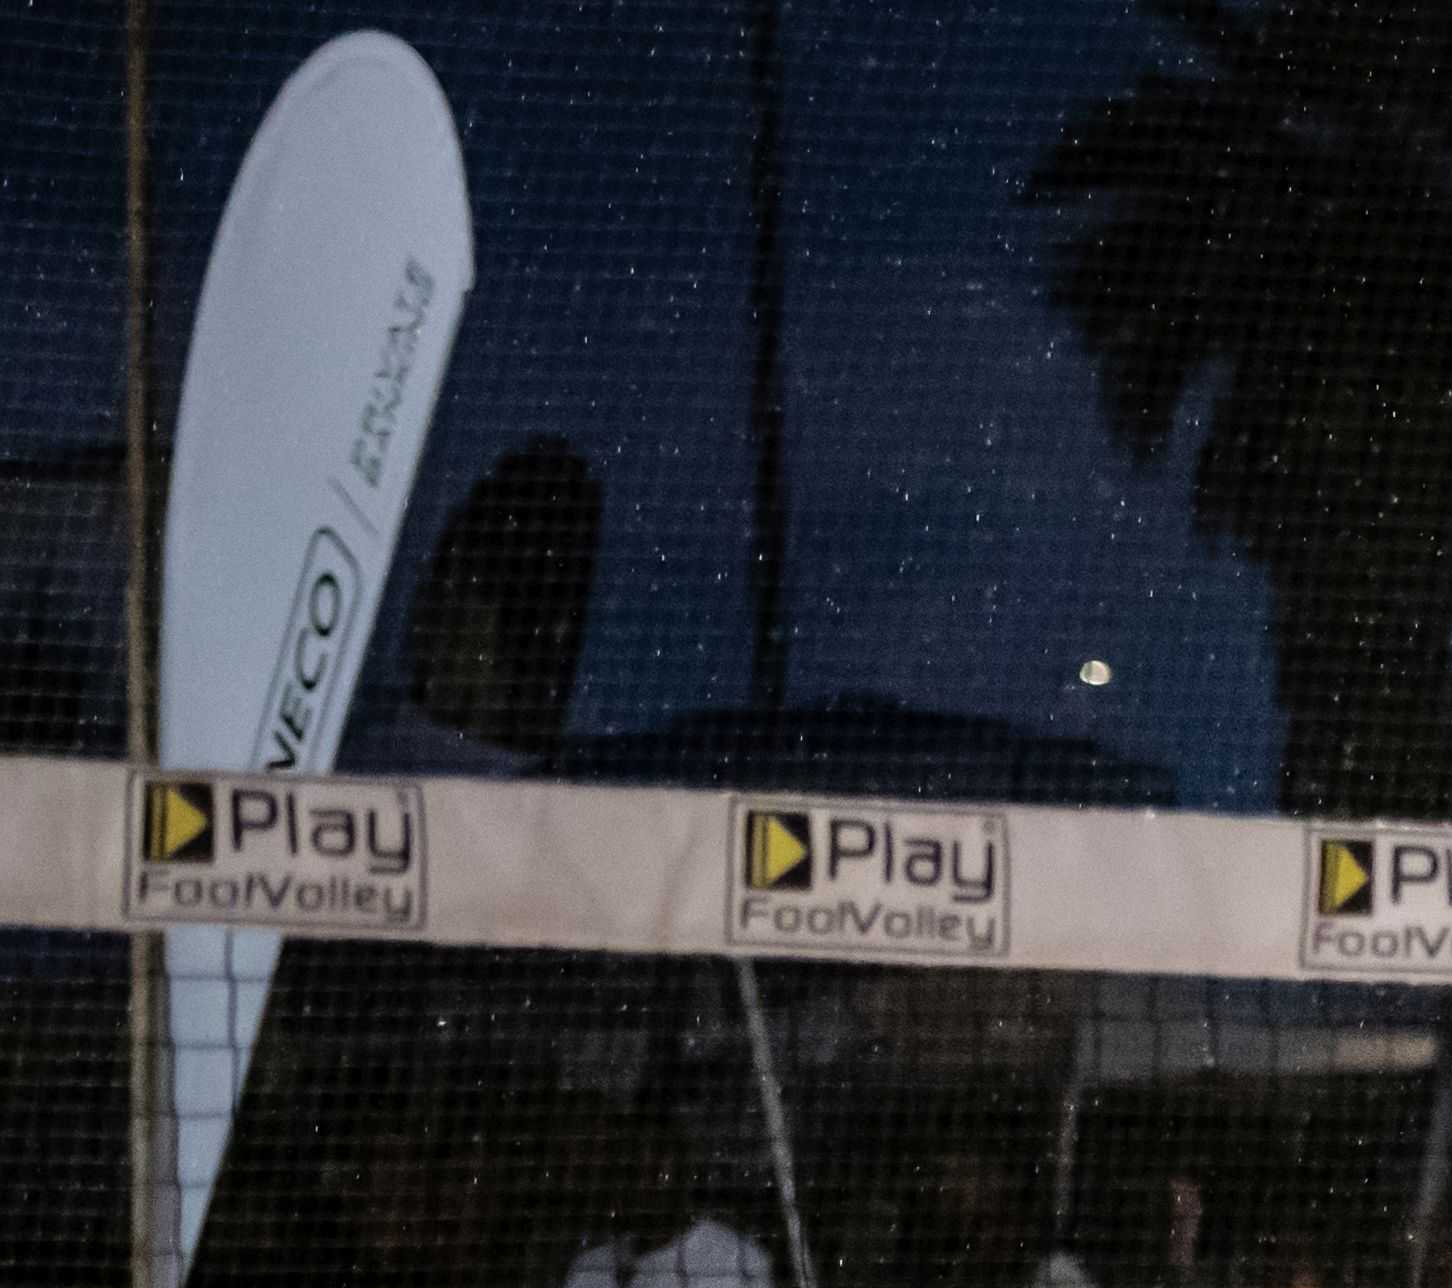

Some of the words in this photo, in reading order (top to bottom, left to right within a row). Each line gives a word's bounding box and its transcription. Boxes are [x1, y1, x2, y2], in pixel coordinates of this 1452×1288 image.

[266, 570, 342, 772] VECO
[230, 788, 413, 876] Play
[829, 817, 995, 904] Play
[137, 868, 411, 924] FootVolley
[739, 897, 996, 952] FootVolley
